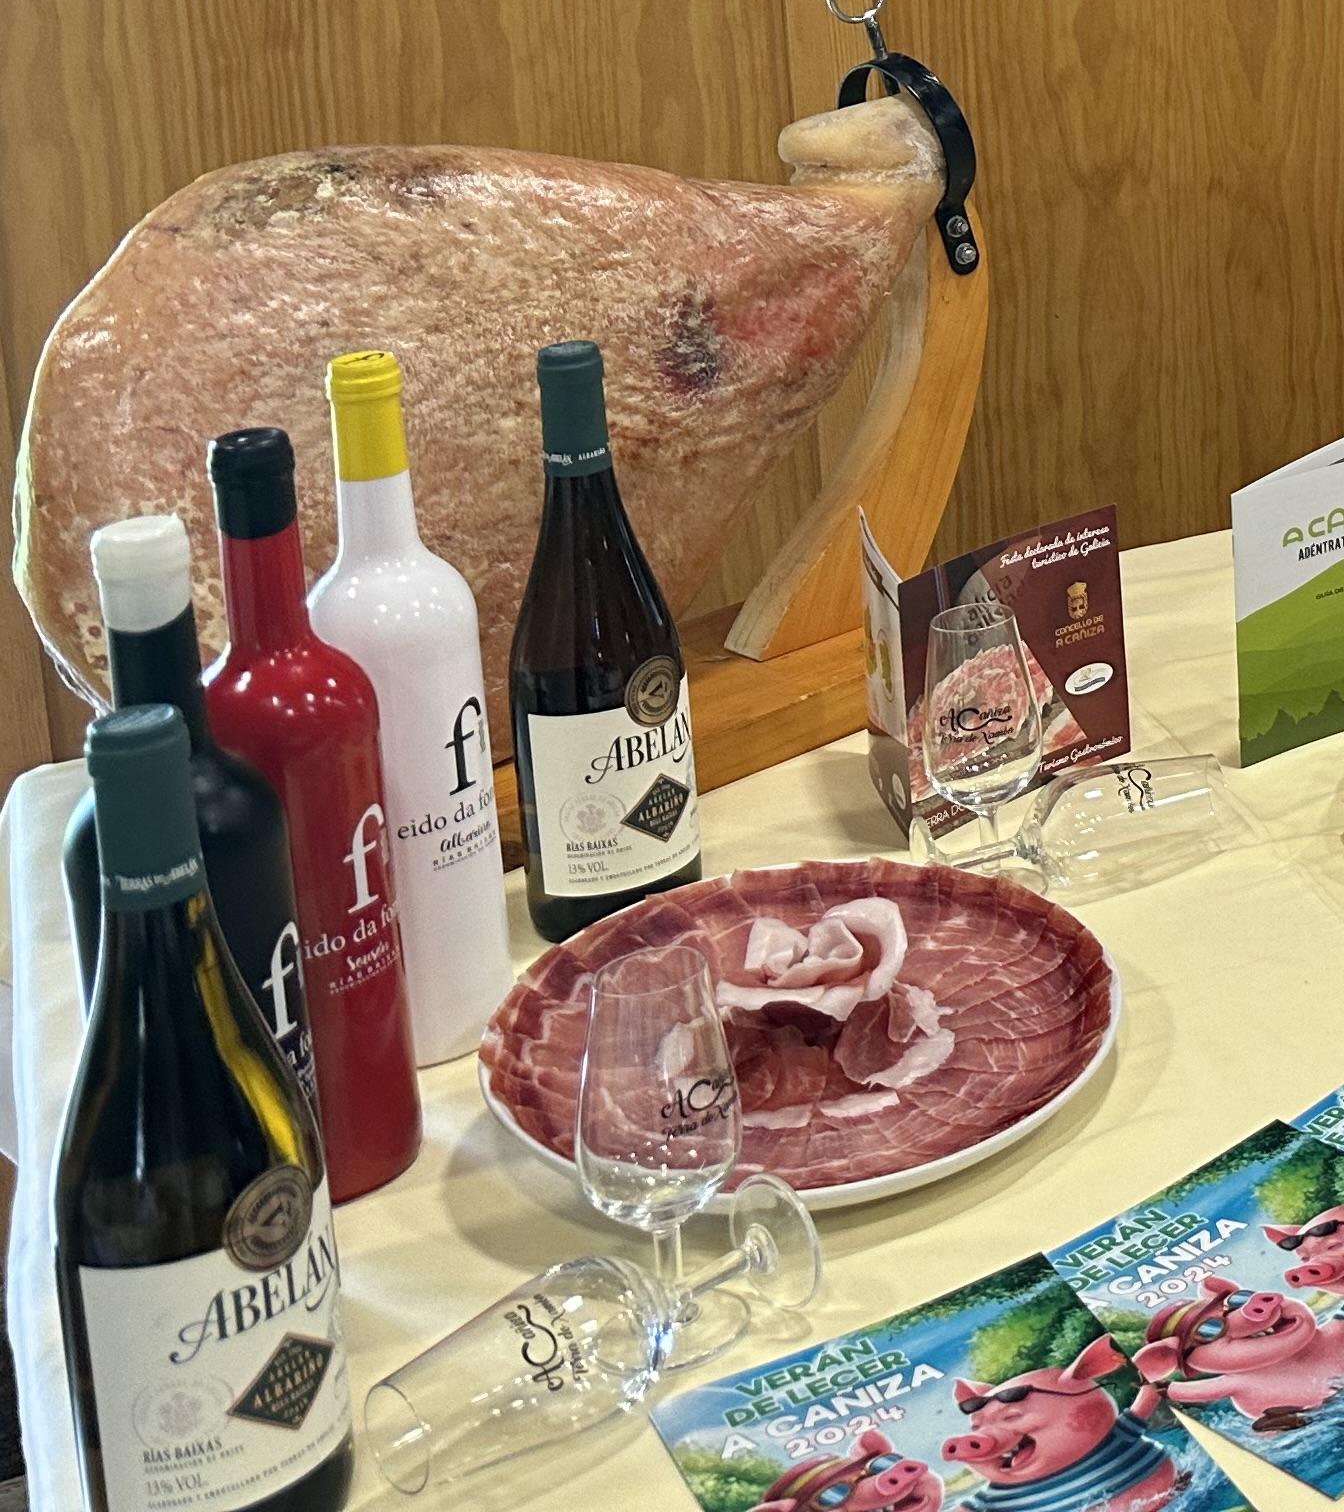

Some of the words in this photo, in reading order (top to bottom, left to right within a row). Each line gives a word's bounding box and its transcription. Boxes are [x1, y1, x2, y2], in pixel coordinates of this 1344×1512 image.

[397, 810, 447, 841] eido
[453, 796, 475, 823] da
[1108, 1218, 1249, 1295] CAÑIZA
[1137, 1255, 1232, 1308] 2024
[724, 1395, 781, 1428] DE
[786, 1351, 911, 1405] LECER
[735, 1338, 876, 1397] VERÁN
[766, 1363, 945, 1438] CAÑIZA
[785, 1404, 905, 1459] 2024
